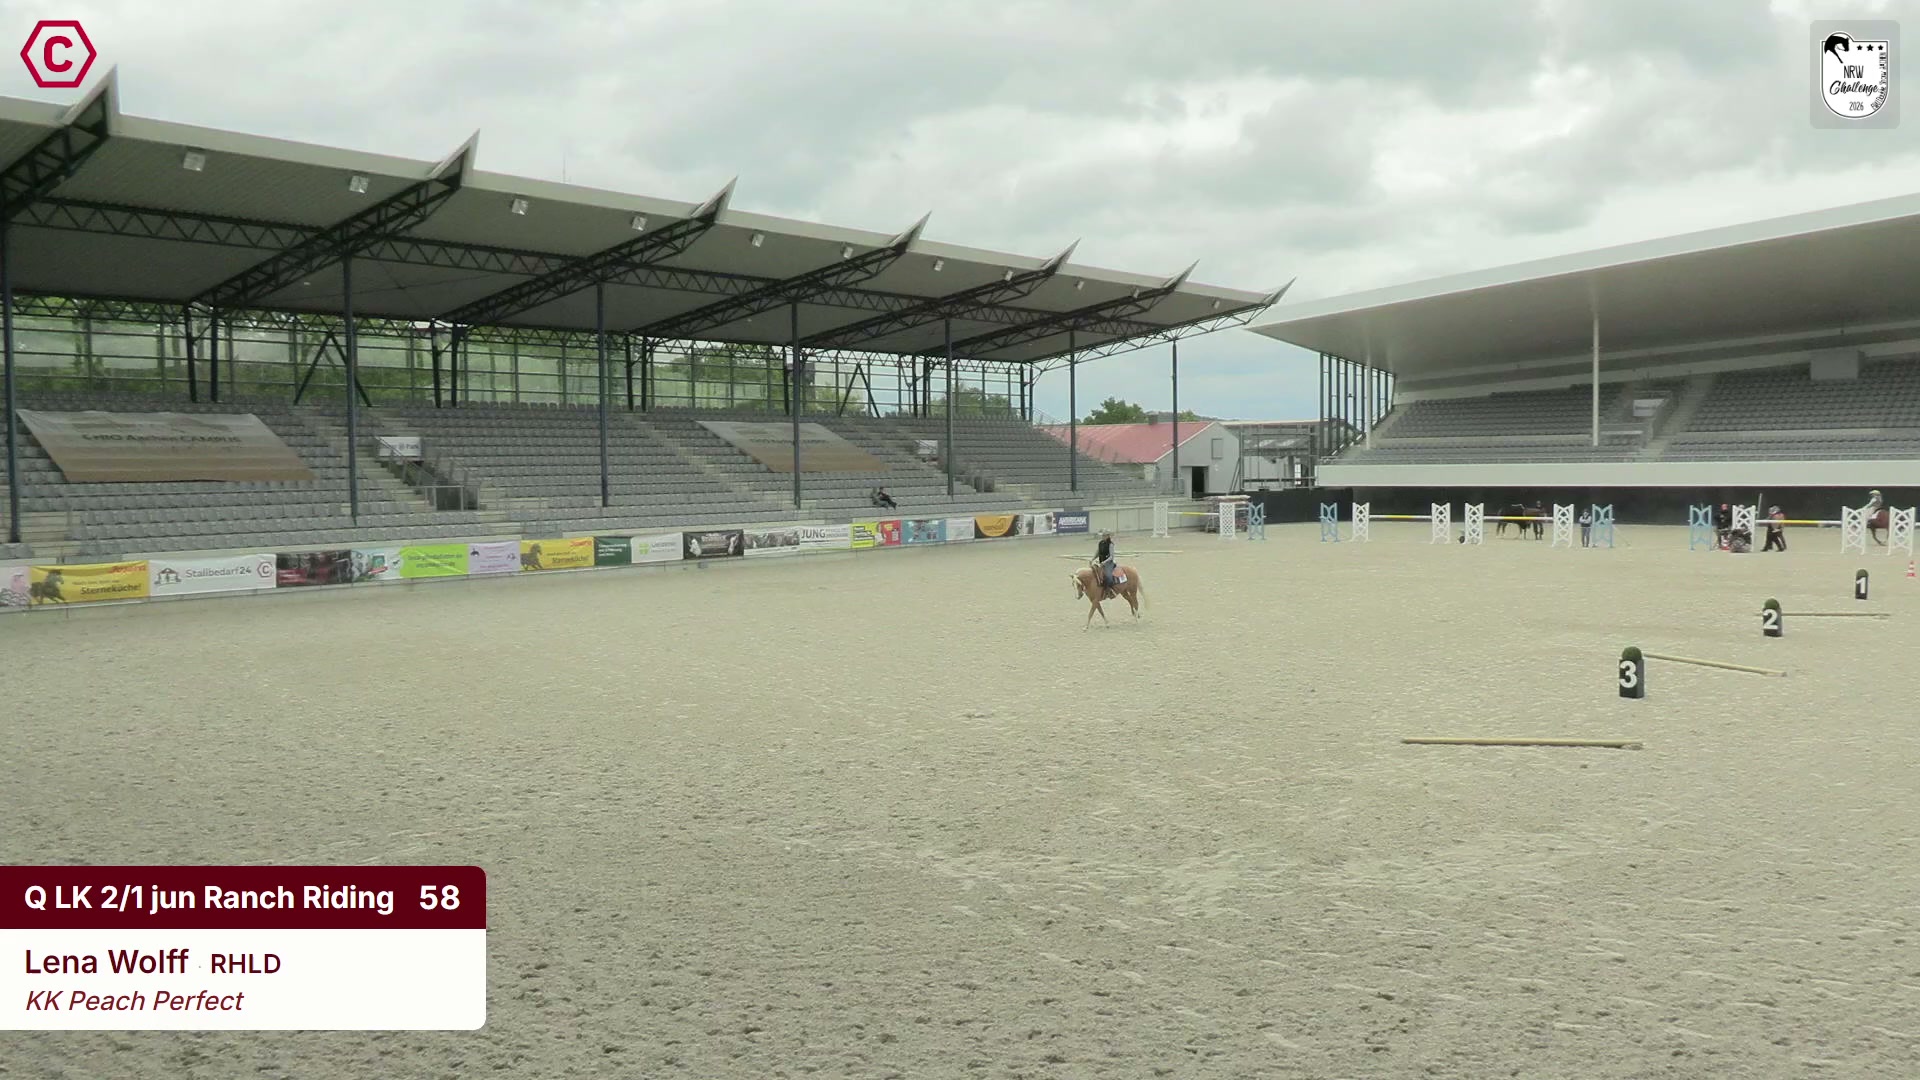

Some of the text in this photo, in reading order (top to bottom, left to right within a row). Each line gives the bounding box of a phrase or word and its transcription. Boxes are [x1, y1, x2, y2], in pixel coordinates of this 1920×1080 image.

[801, 528, 826, 539] JUNG
[185, 566, 252, 578] Stallbedarf24
[1856, 577, 1867, 594] 1
[1763, 609, 1778, 630] 2
[1619, 661, 1637, 688] 3
